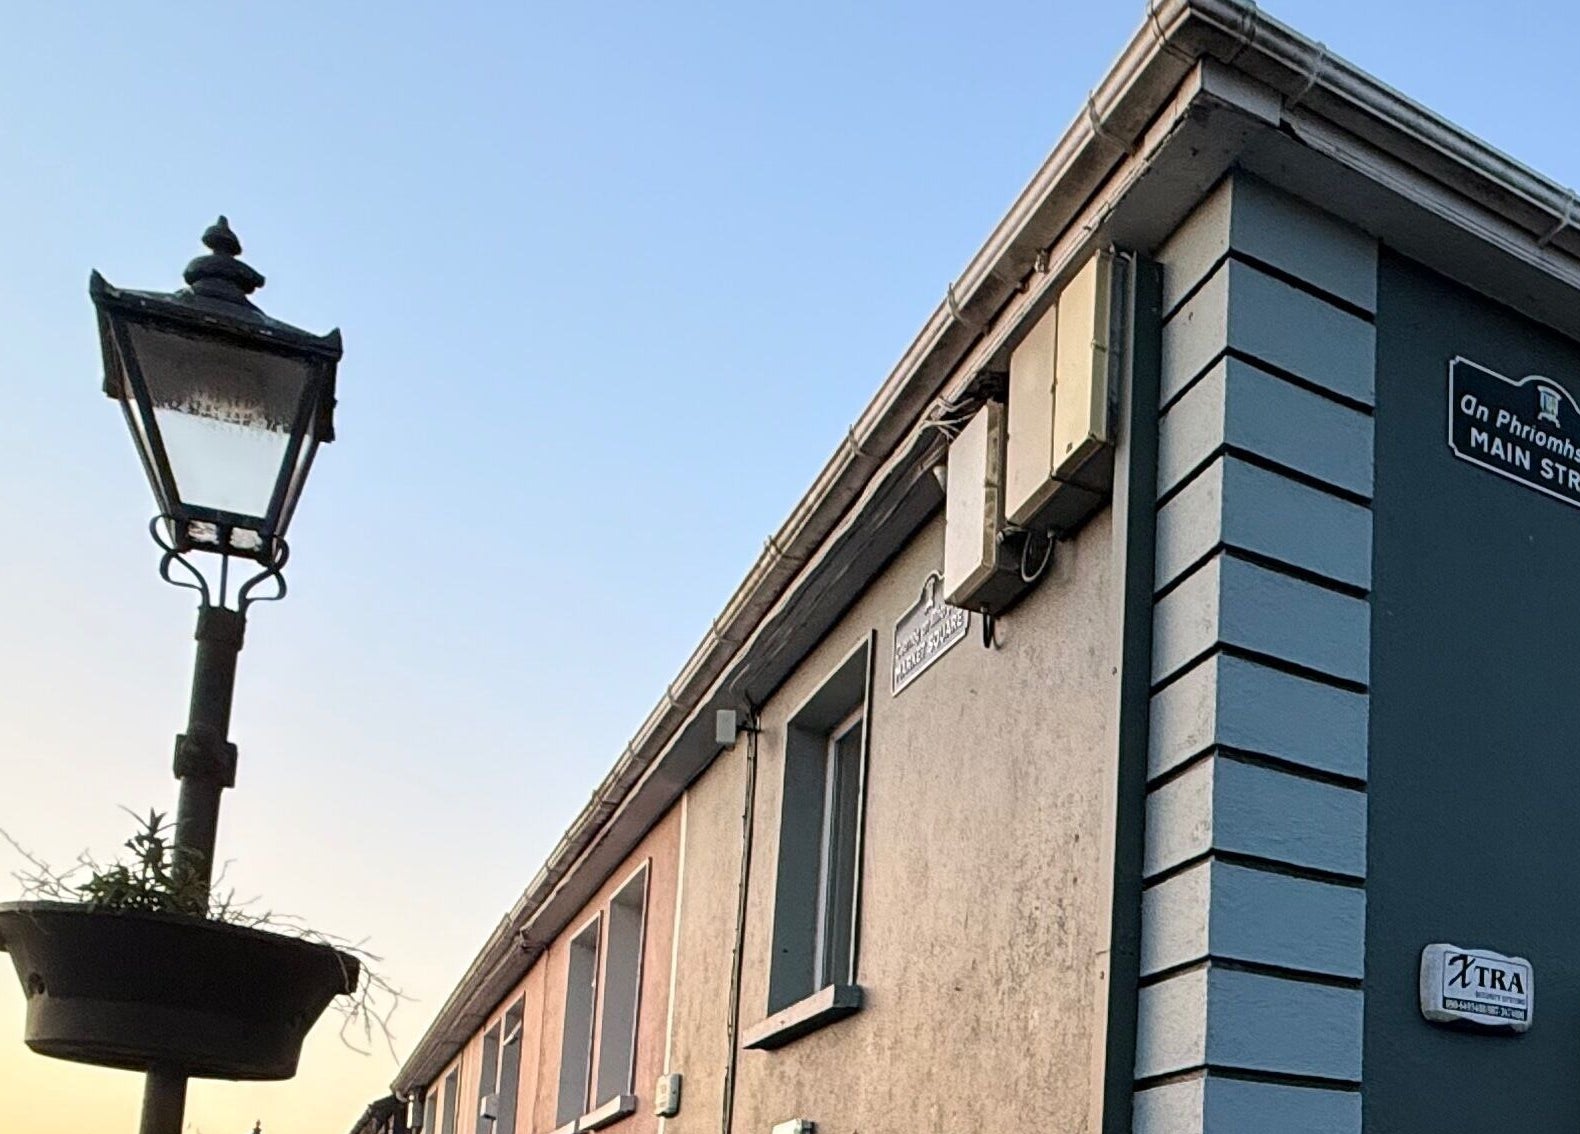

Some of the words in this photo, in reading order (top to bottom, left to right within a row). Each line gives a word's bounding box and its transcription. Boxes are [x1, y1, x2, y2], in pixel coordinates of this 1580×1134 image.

[1461, 394, 1489, 422] An
[1470, 427, 1531, 471] MAIN
[1448, 954, 1524, 994] XTRA
